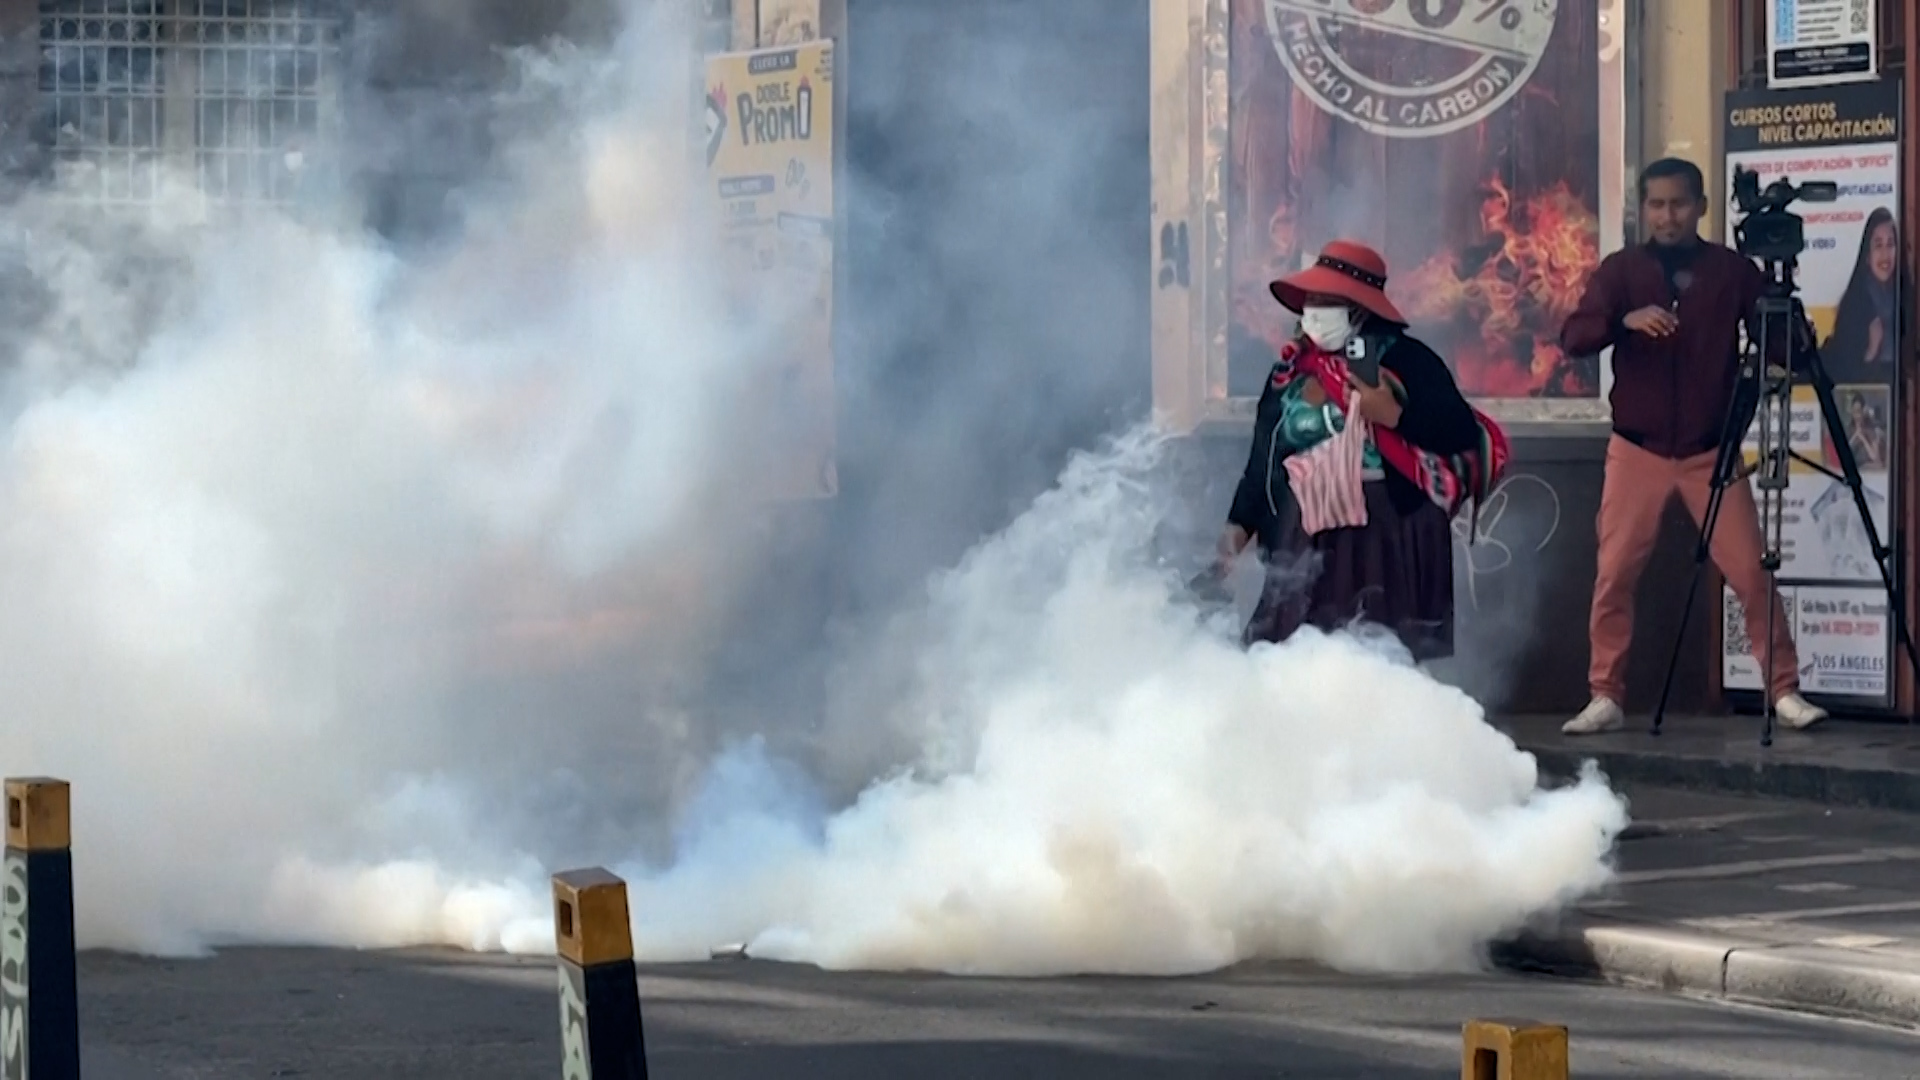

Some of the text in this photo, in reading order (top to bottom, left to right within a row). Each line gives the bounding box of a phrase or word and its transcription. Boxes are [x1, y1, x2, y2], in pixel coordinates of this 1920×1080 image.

[1284, 20, 1512, 124] HECHO AL CARBON
[756, 81, 790, 104] DOBLE
[736, 85, 812, 146] PROMO
[1730, 102, 1836, 126] CURSOS CORTOS
[1759, 113, 1896, 143] NIVEL CAPACITACIÓN
[1775, 162, 1784, 173] DE
[1787, 157, 1853, 173] COMPUTACIÓN
[1817, 653, 1885, 671] LOS ÁNGELES
